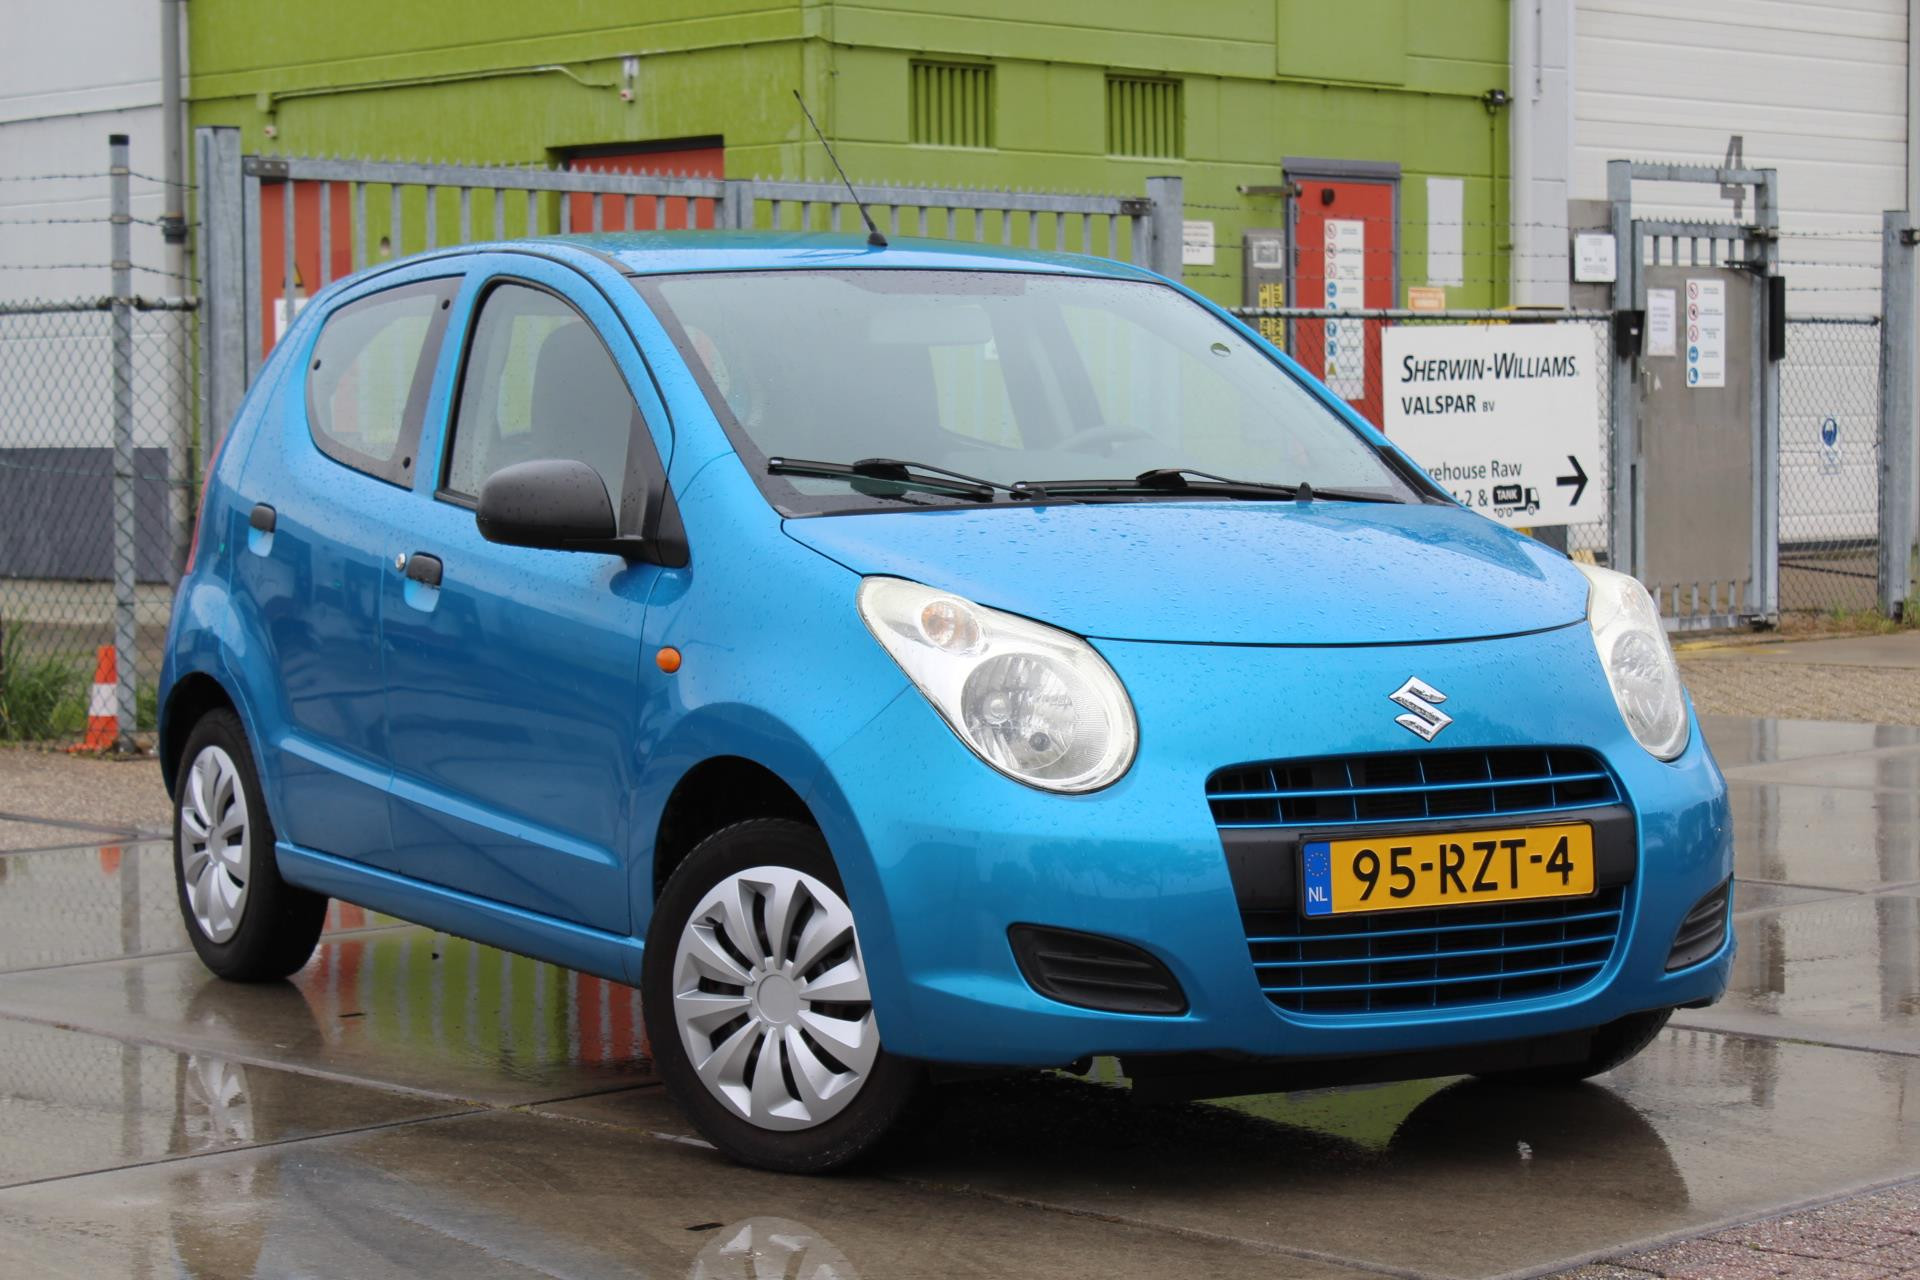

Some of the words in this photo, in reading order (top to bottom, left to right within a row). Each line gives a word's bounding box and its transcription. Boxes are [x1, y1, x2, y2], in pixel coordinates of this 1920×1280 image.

[1720, 135, 1745, 219] 4
[1401, 395, 1477, 416] VALSPAR
[1482, 401, 1495, 413] BV
[1424, 461, 1487, 481] rehouse
[1491, 460, 1522, 478] Raw
[1478, 488, 1488, 507] &
[1496, 488, 1518, 501] TANK
[1352, 836, 1574, 901] 95-RZT-4
[1308, 886, 1328, 903] NL
